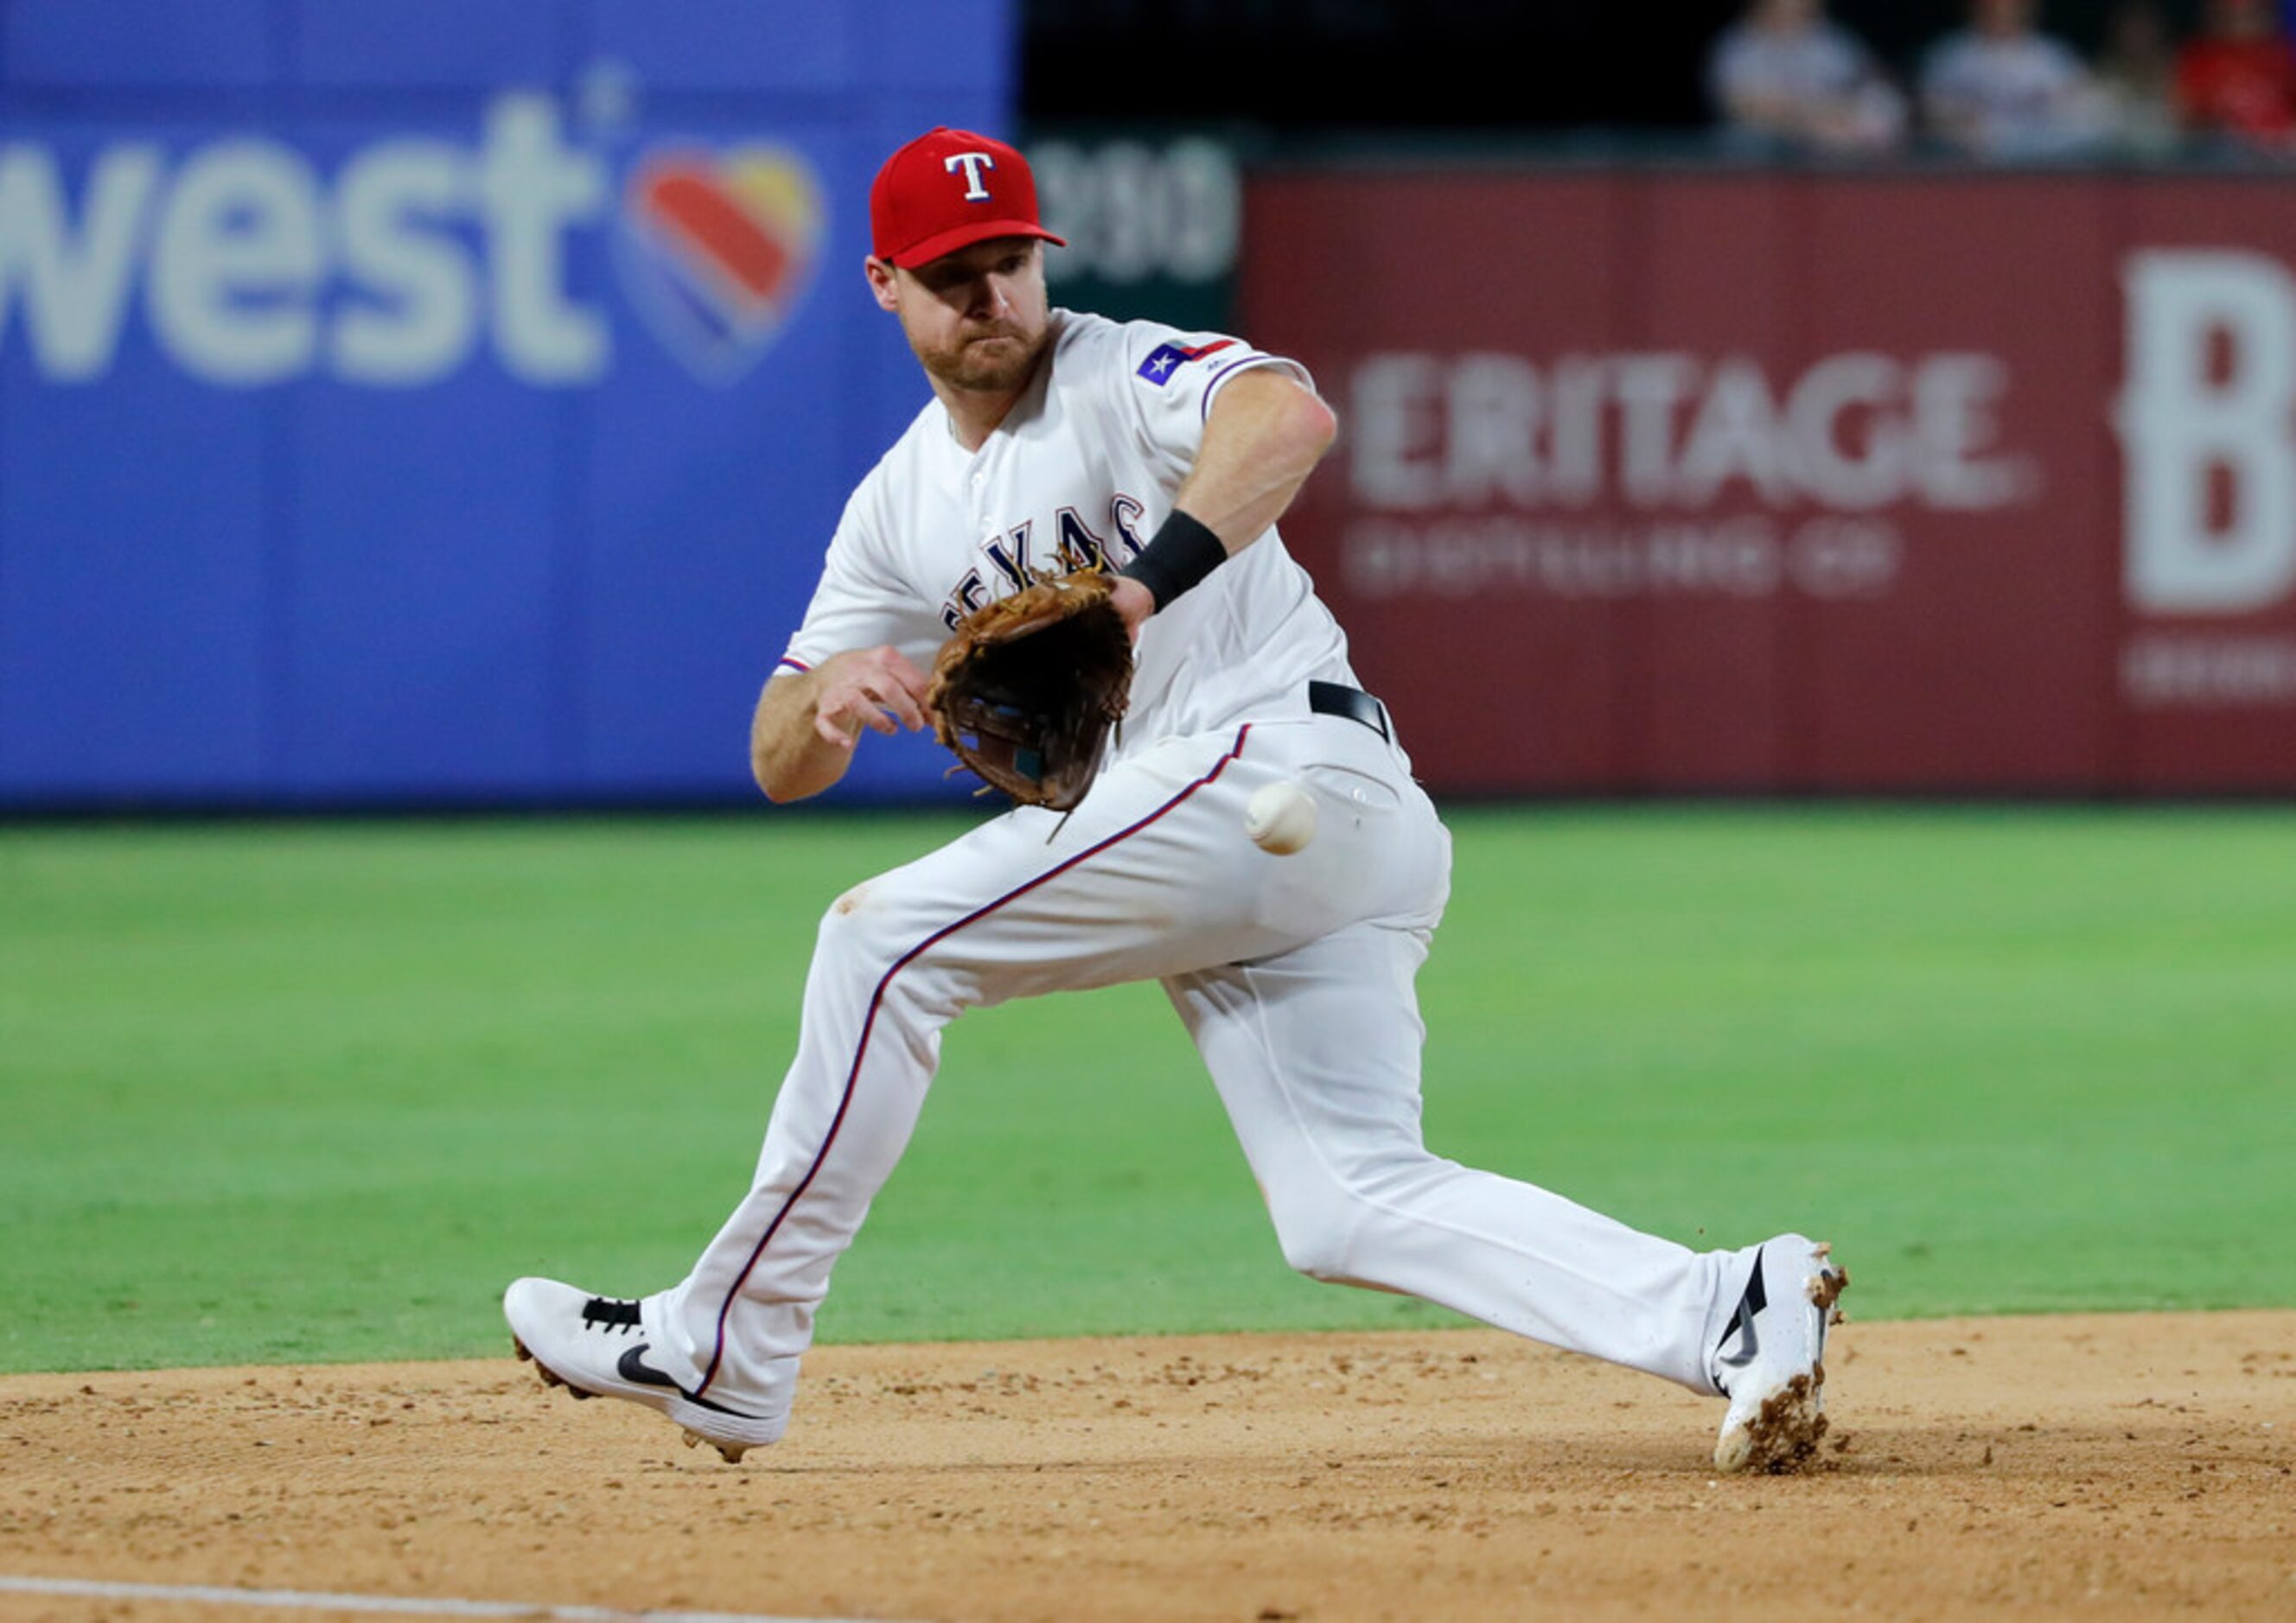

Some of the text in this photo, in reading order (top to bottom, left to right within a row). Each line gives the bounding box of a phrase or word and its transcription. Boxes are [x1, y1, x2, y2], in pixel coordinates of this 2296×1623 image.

[0, 91, 612, 385] west
[944, 150, 998, 203] T
[1344, 351, 2031, 510] ERITAGE
[939, 493, 1147, 633] EXAS
